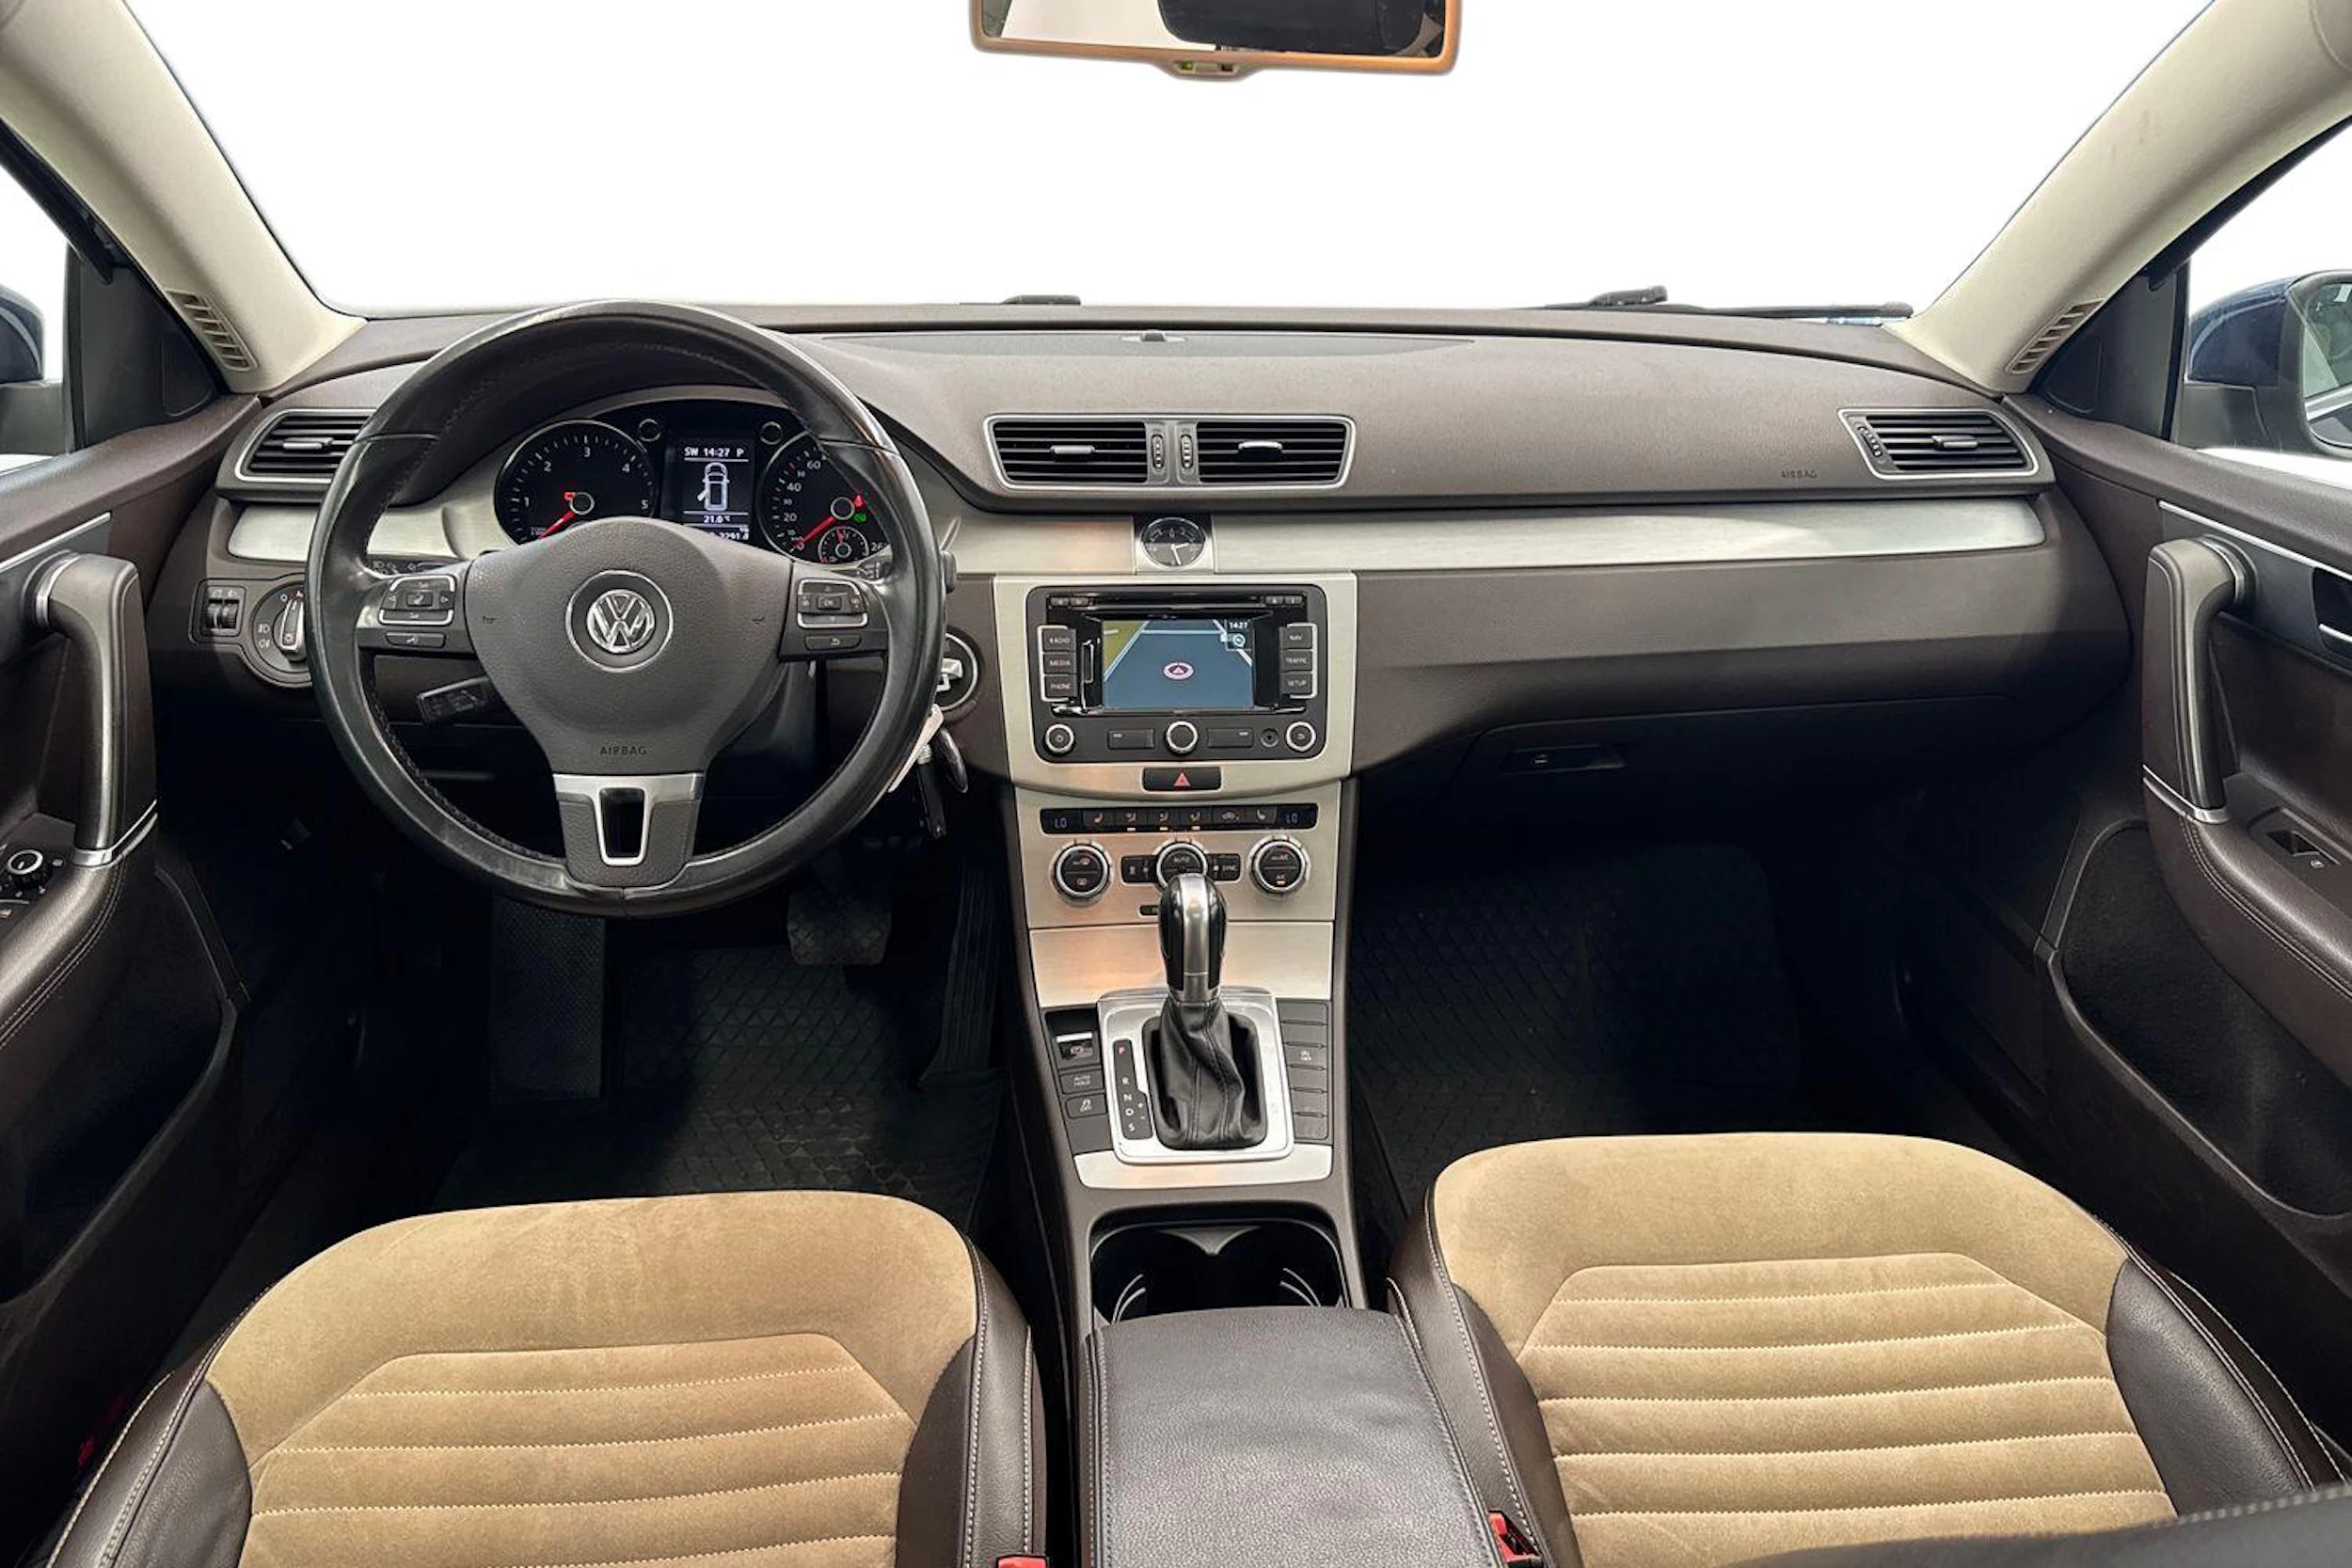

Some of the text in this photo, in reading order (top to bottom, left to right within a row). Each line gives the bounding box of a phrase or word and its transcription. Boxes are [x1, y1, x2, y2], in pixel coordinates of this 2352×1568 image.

[583, 447, 591, 458] 3
[703, 448, 730, 457] 14:27
[736, 448, 745, 457] P
[543, 460, 552, 472] 2
[621, 463, 630, 473] 4
[806, 460, 821, 469] 60
[787, 482, 803, 492] 40
[523, 497, 530, 507] 1
[641, 499, 649, 510] 5
[783, 512, 798, 522] 20
[599, 745, 647, 755] AIRBAG
